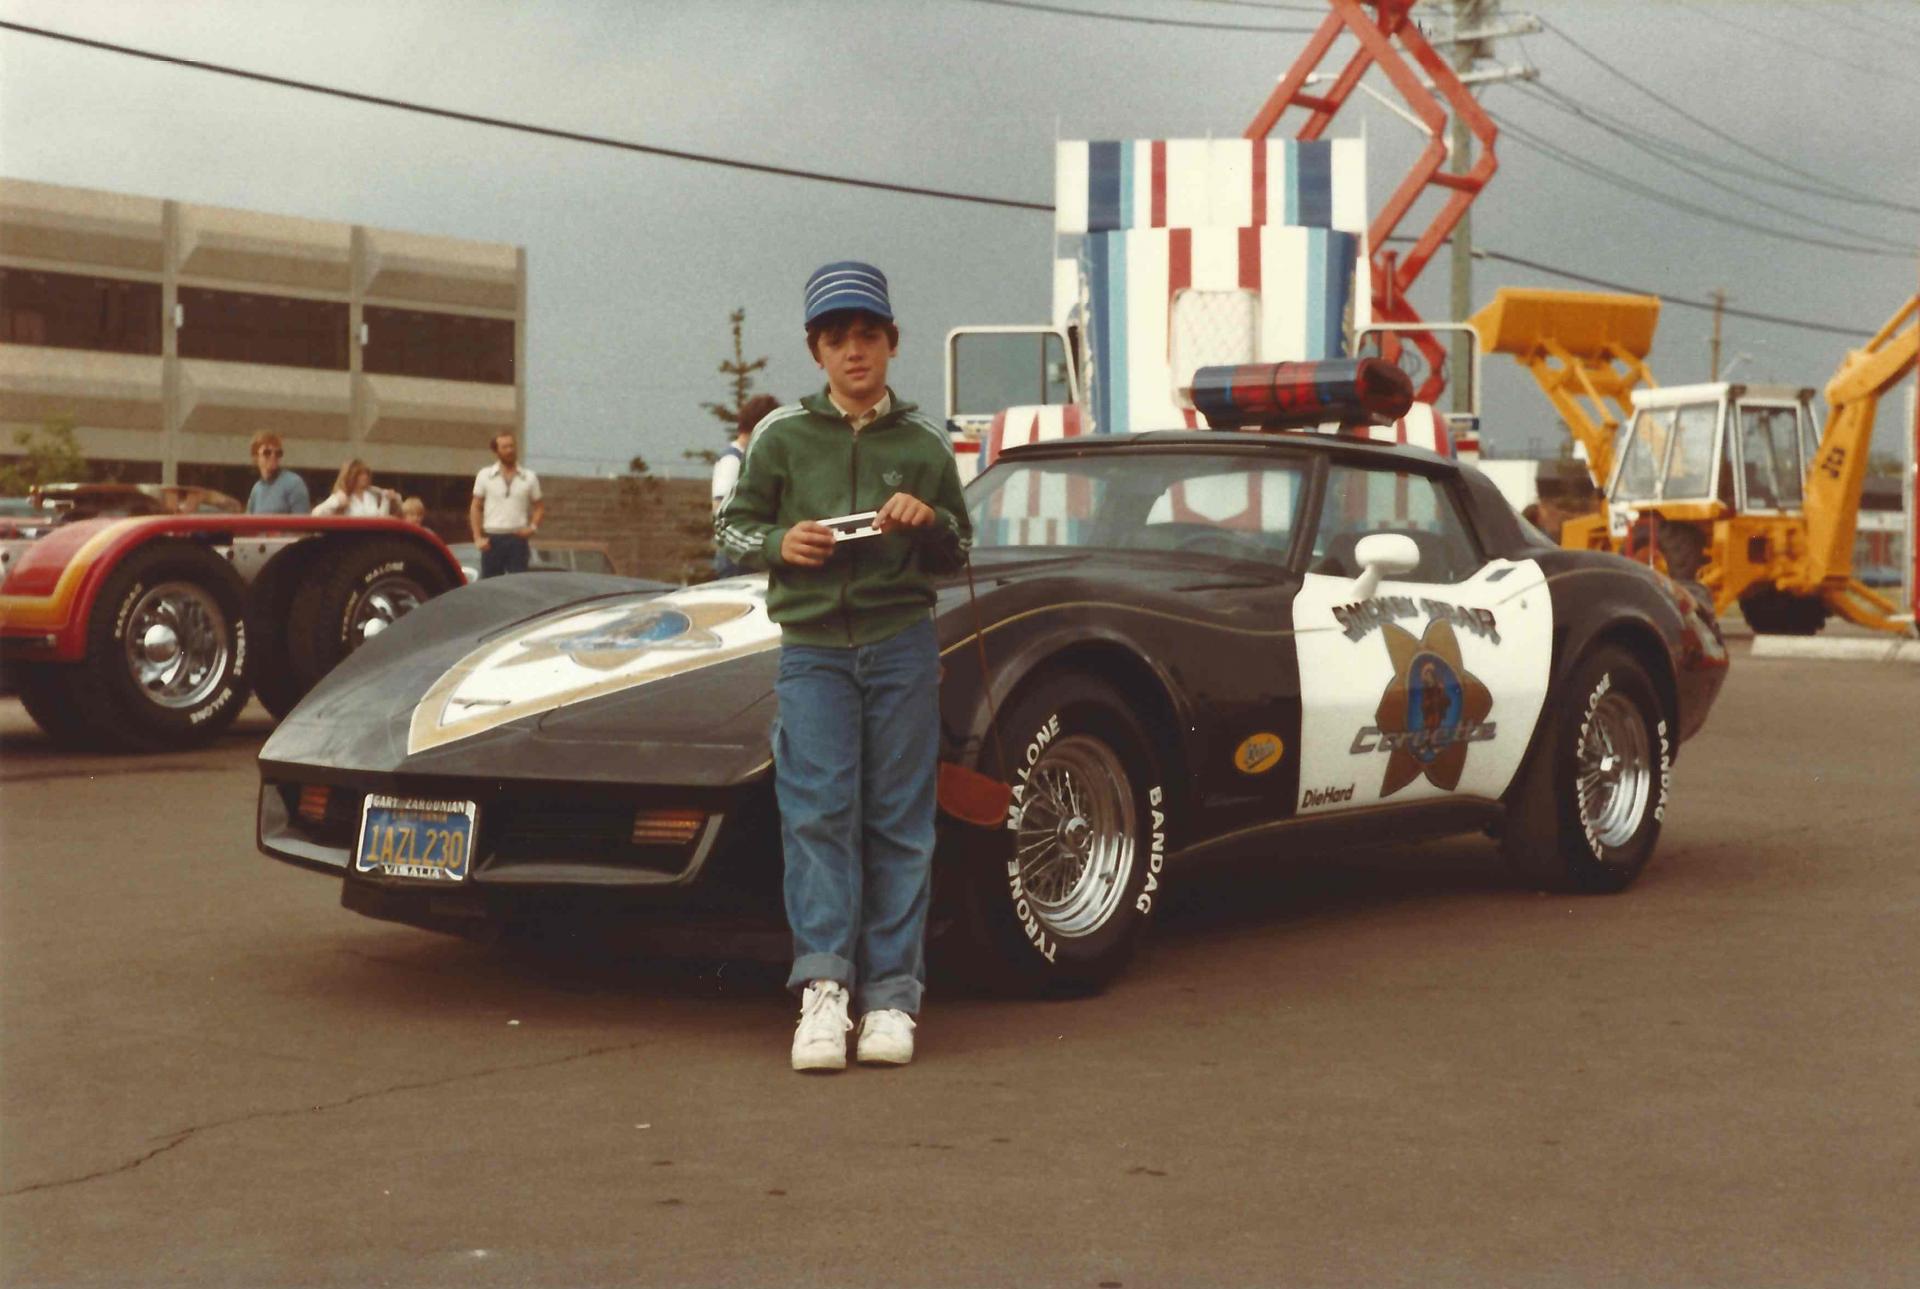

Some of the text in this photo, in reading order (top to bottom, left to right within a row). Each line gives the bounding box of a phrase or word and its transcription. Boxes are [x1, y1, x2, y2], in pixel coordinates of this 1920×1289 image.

[365, 561, 405, 583] MALONE
[1301, 784, 1355, 808] DieHard
[367, 824, 465, 868] 1AZL230
[1007, 714, 1061, 963] TYRONE MALONE
[1136, 786, 1164, 914] BANDAG
